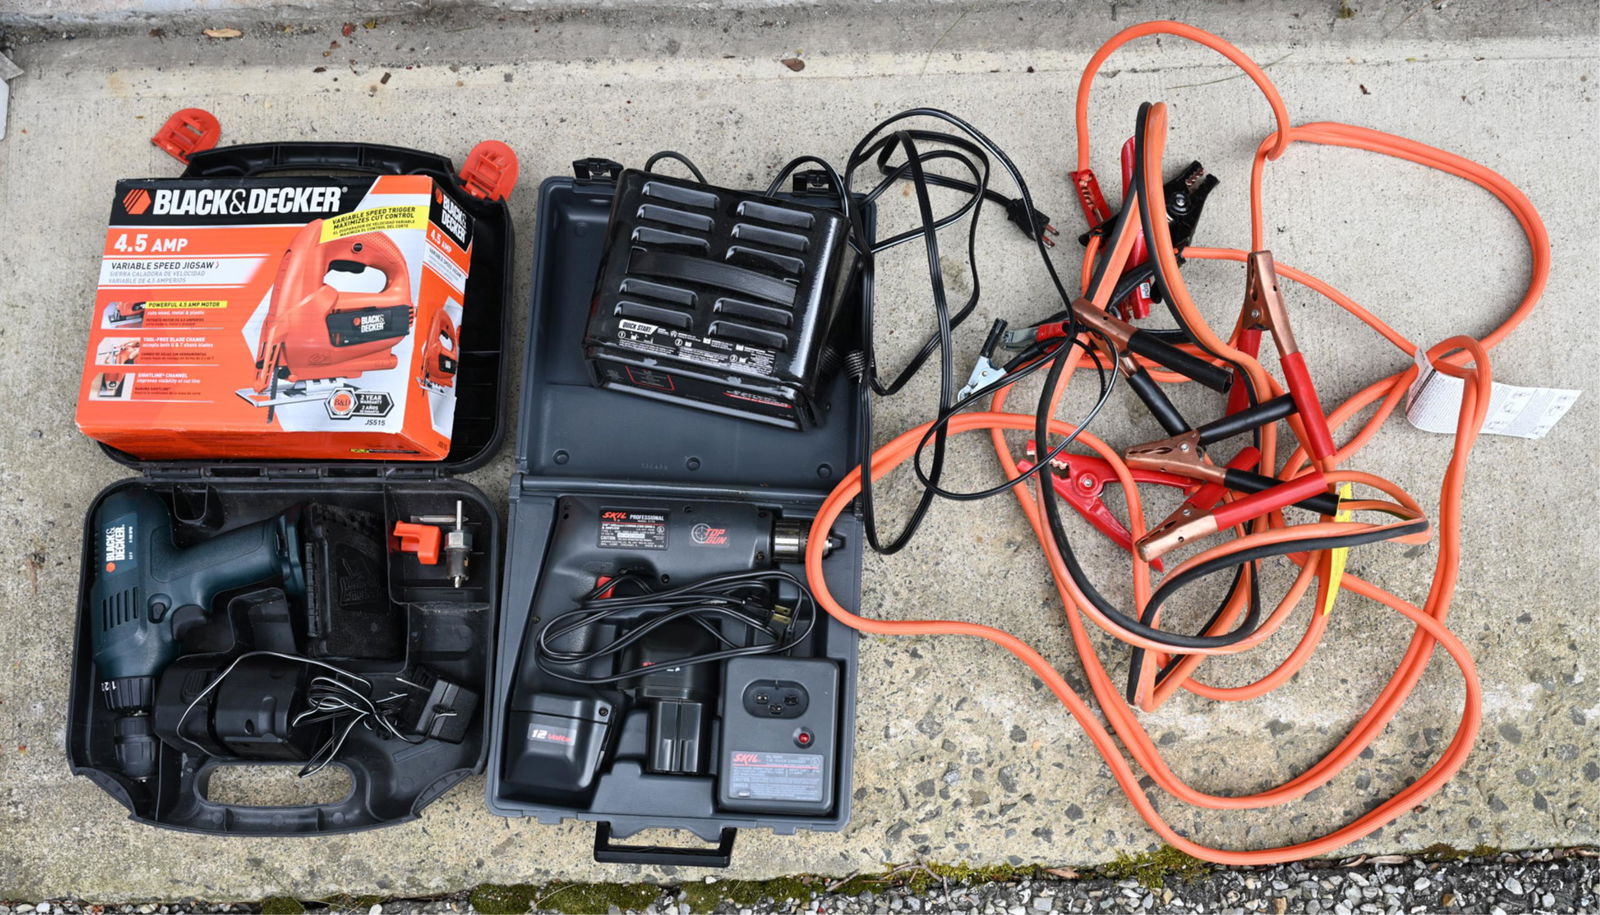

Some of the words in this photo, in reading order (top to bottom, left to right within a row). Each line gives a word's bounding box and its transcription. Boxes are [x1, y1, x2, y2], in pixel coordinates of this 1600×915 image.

[332, 211, 364, 224] VARIABLE
[366, 208, 387, 216] SPEED
[389, 206, 416, 214] TRIGGER
[333, 217, 370, 230] MAXIMIZES
[442, 208, 467, 243] DECKER
[114, 233, 148, 252] 4.5
[151, 238, 188, 252] AMP
[431, 229, 442, 245] 4.5
[441, 240, 452, 253] AMP
[111, 262, 152, 270] VARIABLE
[153, 262, 181, 270] SPEED
[182, 261, 215, 269] JIGSAW
[361, 314, 385, 324] BLACK&
[361, 323, 384, 333] DECKER
[622, 321, 637, 329] QUICK
[637, 324, 652, 332] START
[602, 511, 627, 521] SKIL
[705, 528, 726, 536] TOP
[704, 536, 727, 545] GUN
[532, 729, 547, 739] 12
[735, 753, 759, 764] SKIL
